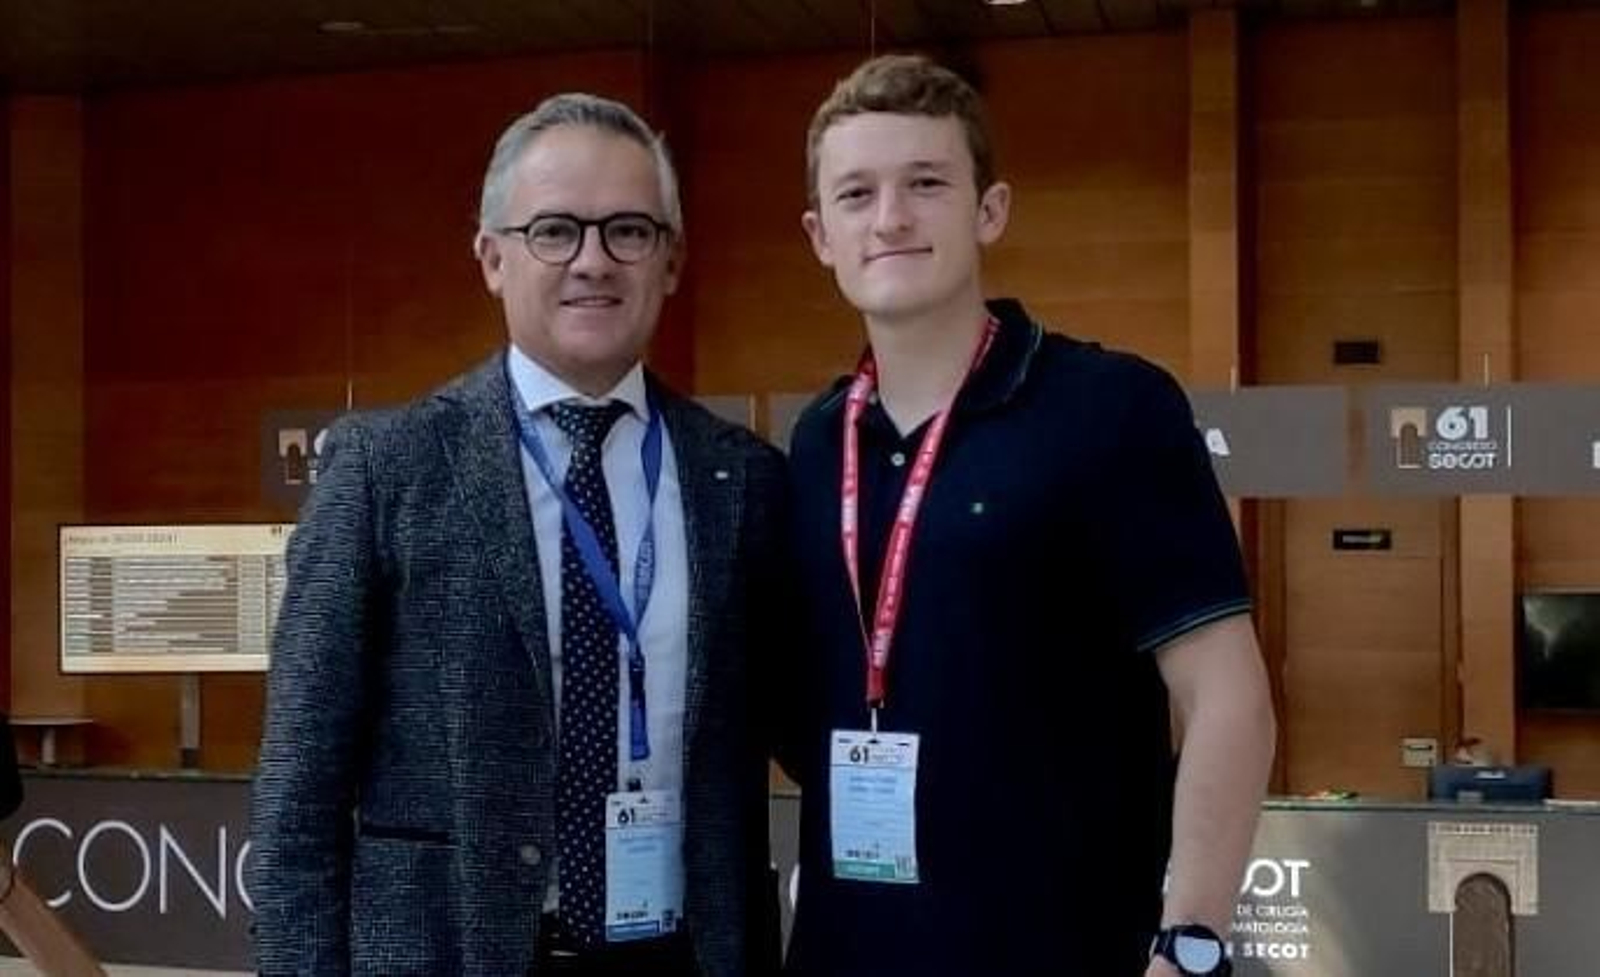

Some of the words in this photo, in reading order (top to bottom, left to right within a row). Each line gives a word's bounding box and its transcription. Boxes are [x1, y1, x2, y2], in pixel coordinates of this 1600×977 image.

[1436, 406, 1488, 440] 61
[850, 746, 869, 764] 61
[1240, 859, 1310, 897] OT
[1236, 904, 1253, 916] DE
[1243, 943, 1309, 958] SECOT
